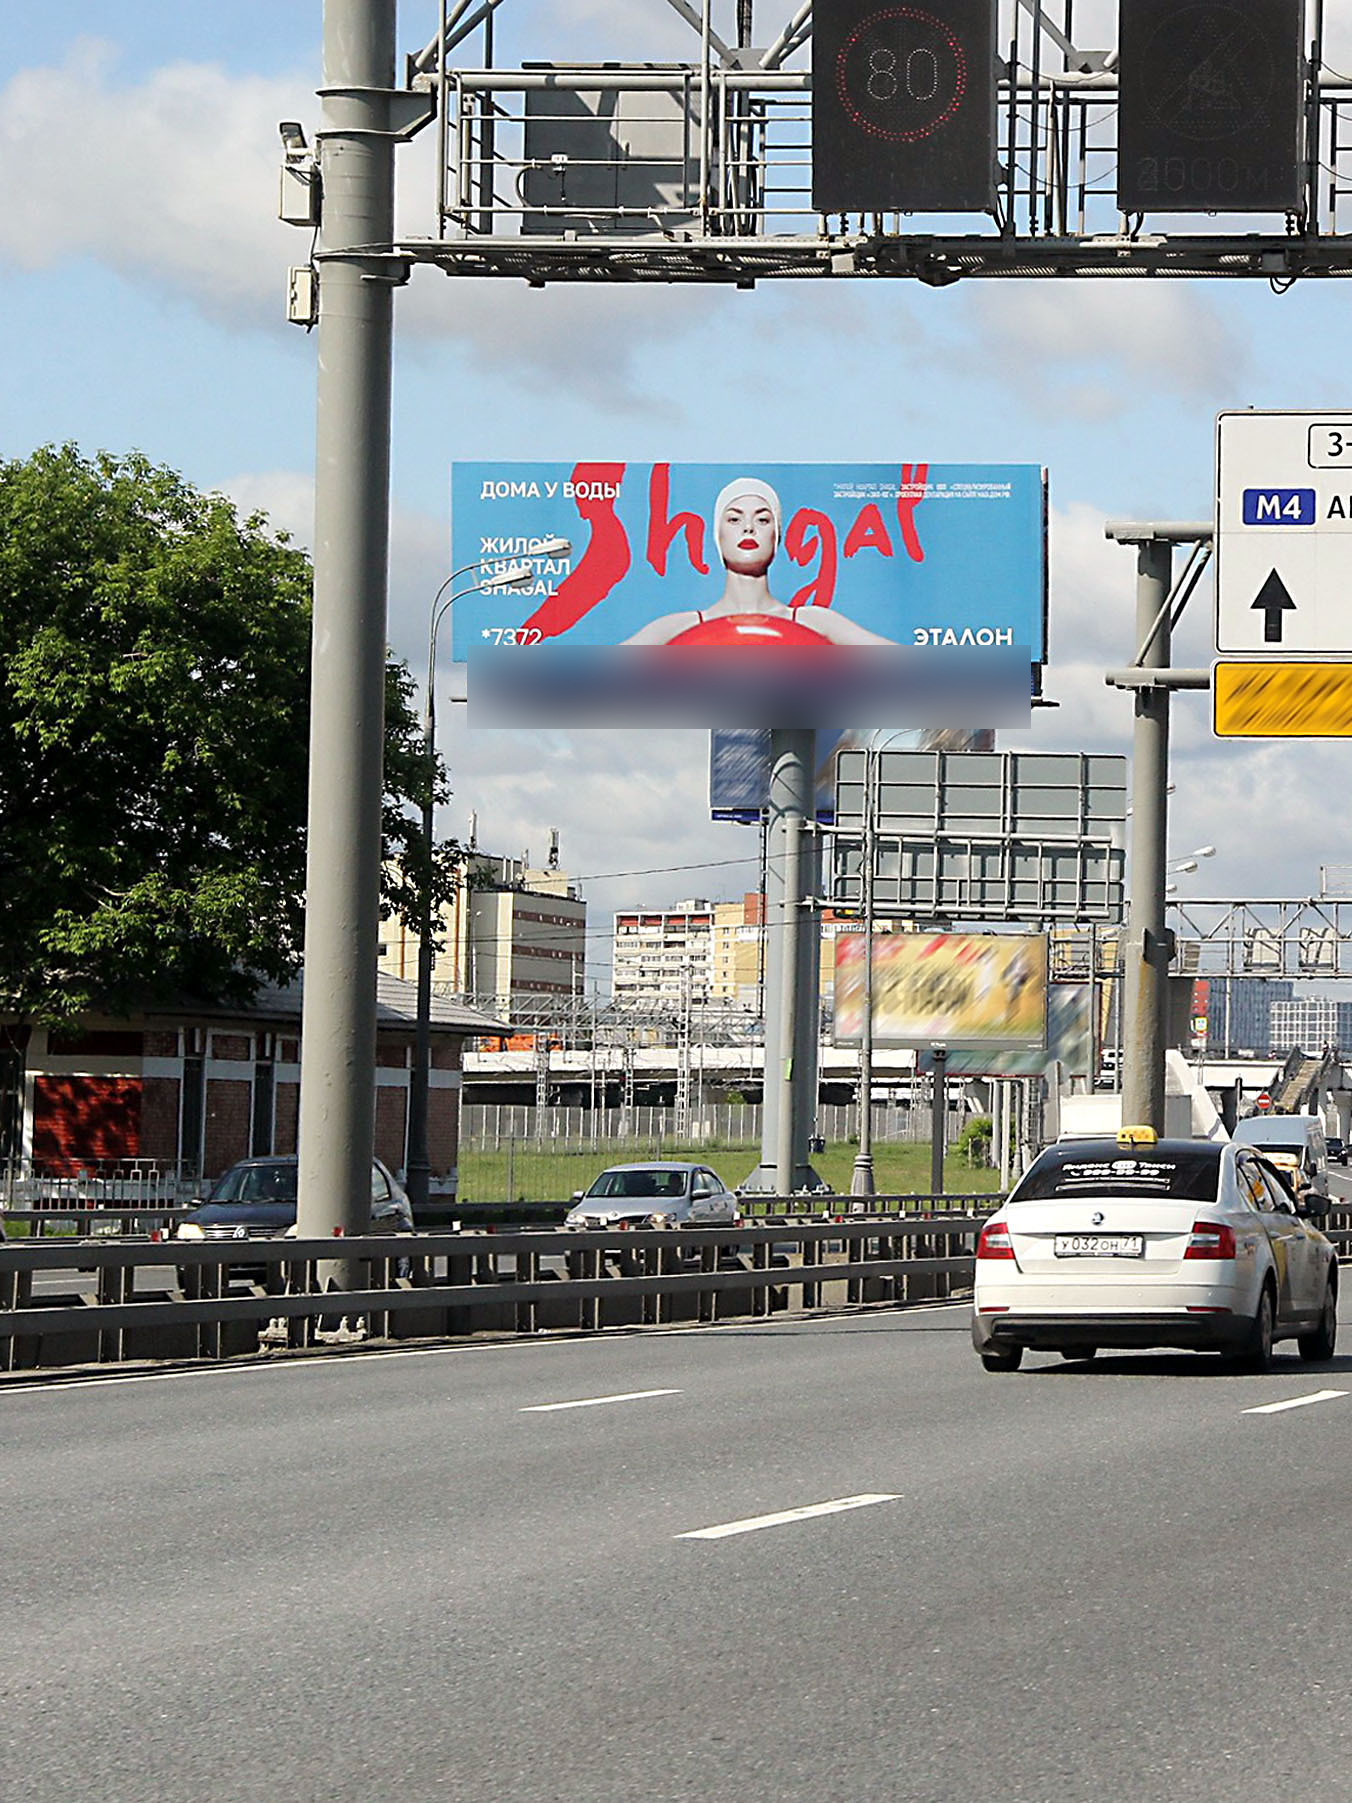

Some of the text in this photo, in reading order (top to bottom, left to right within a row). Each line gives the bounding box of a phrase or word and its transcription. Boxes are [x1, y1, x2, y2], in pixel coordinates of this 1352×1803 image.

[867, 48, 938, 100] 80
[480, 481, 620, 501] ДОМА У ВОДЫ
[1256, 494, 1302, 520] М4
[480, 559, 570, 575] КВАРТАЛ
[913, 628, 1012, 645] ЭТАЛОН
